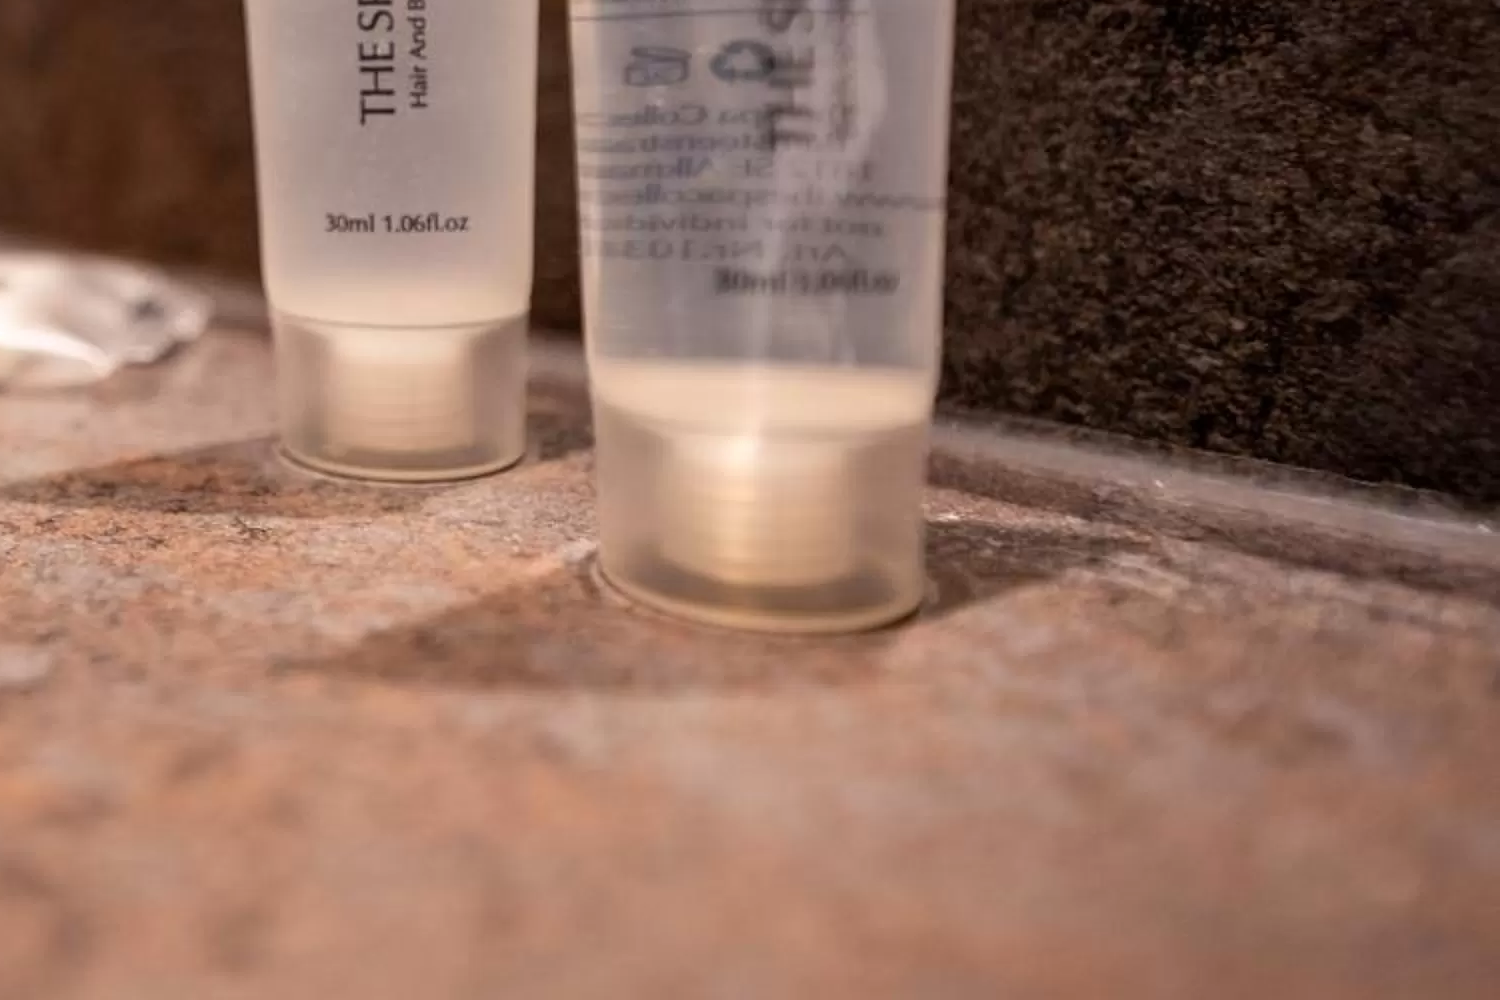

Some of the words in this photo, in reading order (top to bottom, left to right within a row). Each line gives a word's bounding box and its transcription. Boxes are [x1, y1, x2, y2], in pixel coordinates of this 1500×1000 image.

[406, 14, 428, 61] And
[357, 41, 395, 126] THE
[408, 64, 428, 110] Hair
[325, 211, 376, 233] 30ml
[379, 211, 471, 233] 1.06fl.oz
